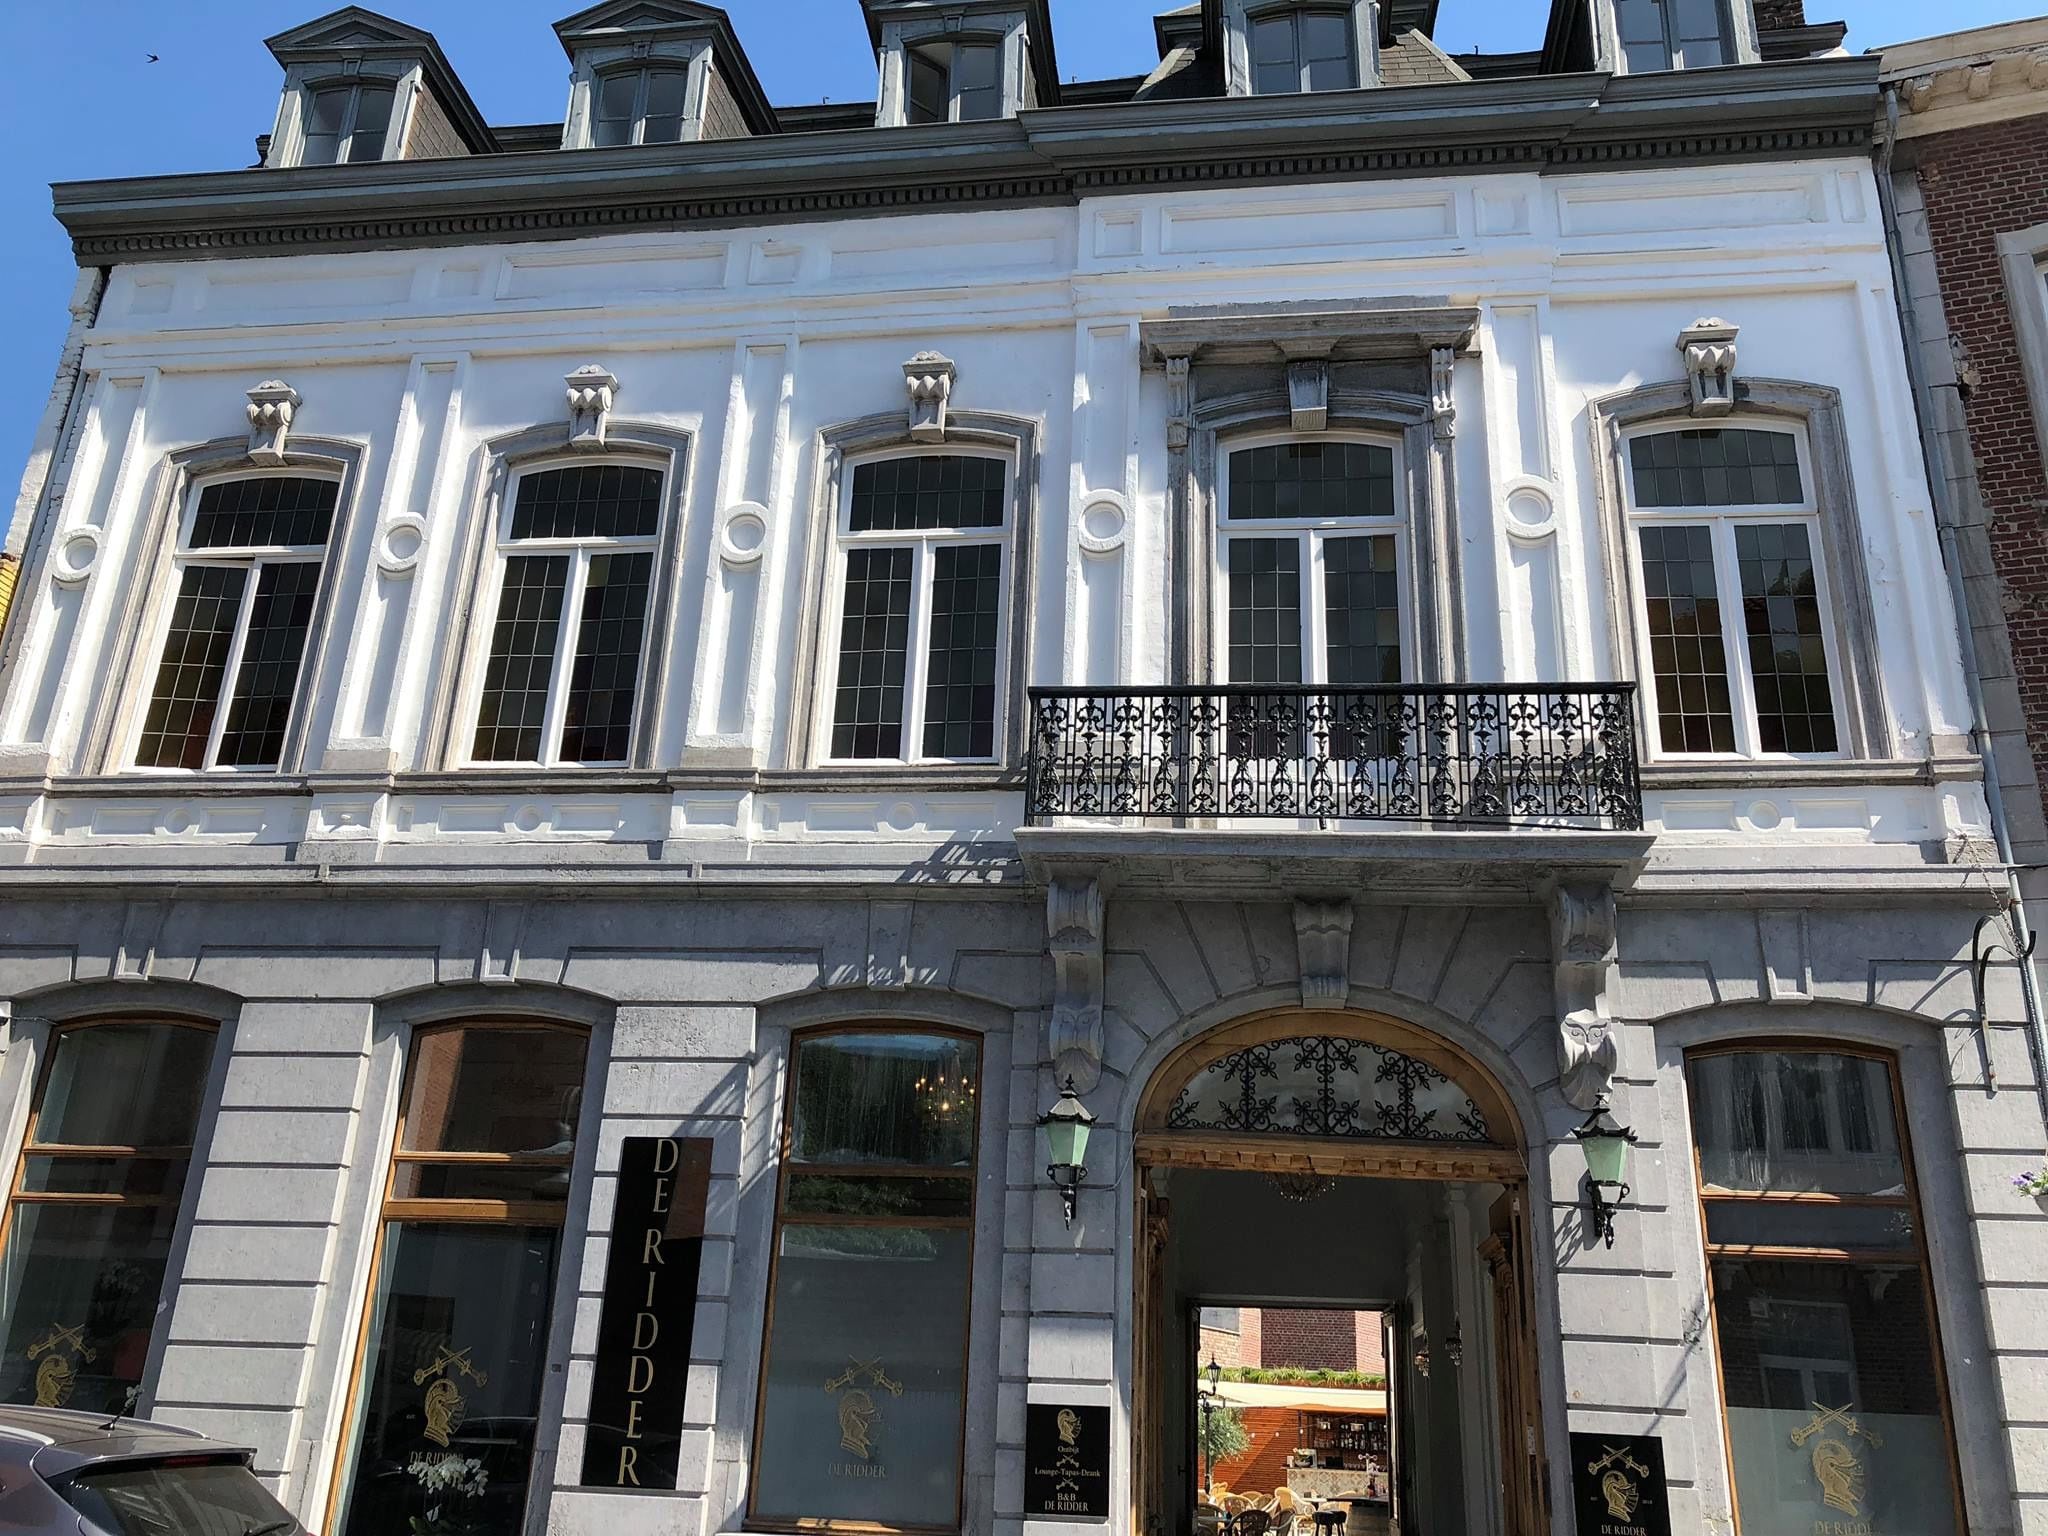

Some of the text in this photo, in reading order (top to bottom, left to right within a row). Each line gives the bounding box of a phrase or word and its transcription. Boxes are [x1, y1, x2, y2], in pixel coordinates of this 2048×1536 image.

[616, 1138, 679, 1487] DE RIDDER
[844, 1463, 886, 1478] RIDDER
[1057, 1493, 1076, 1501] B&B
[1044, 1500, 1089, 1512] DE RIDDER
[1601, 1524, 1647, 1536] DE RIDDER
[1815, 1520, 1830, 1535] DE
